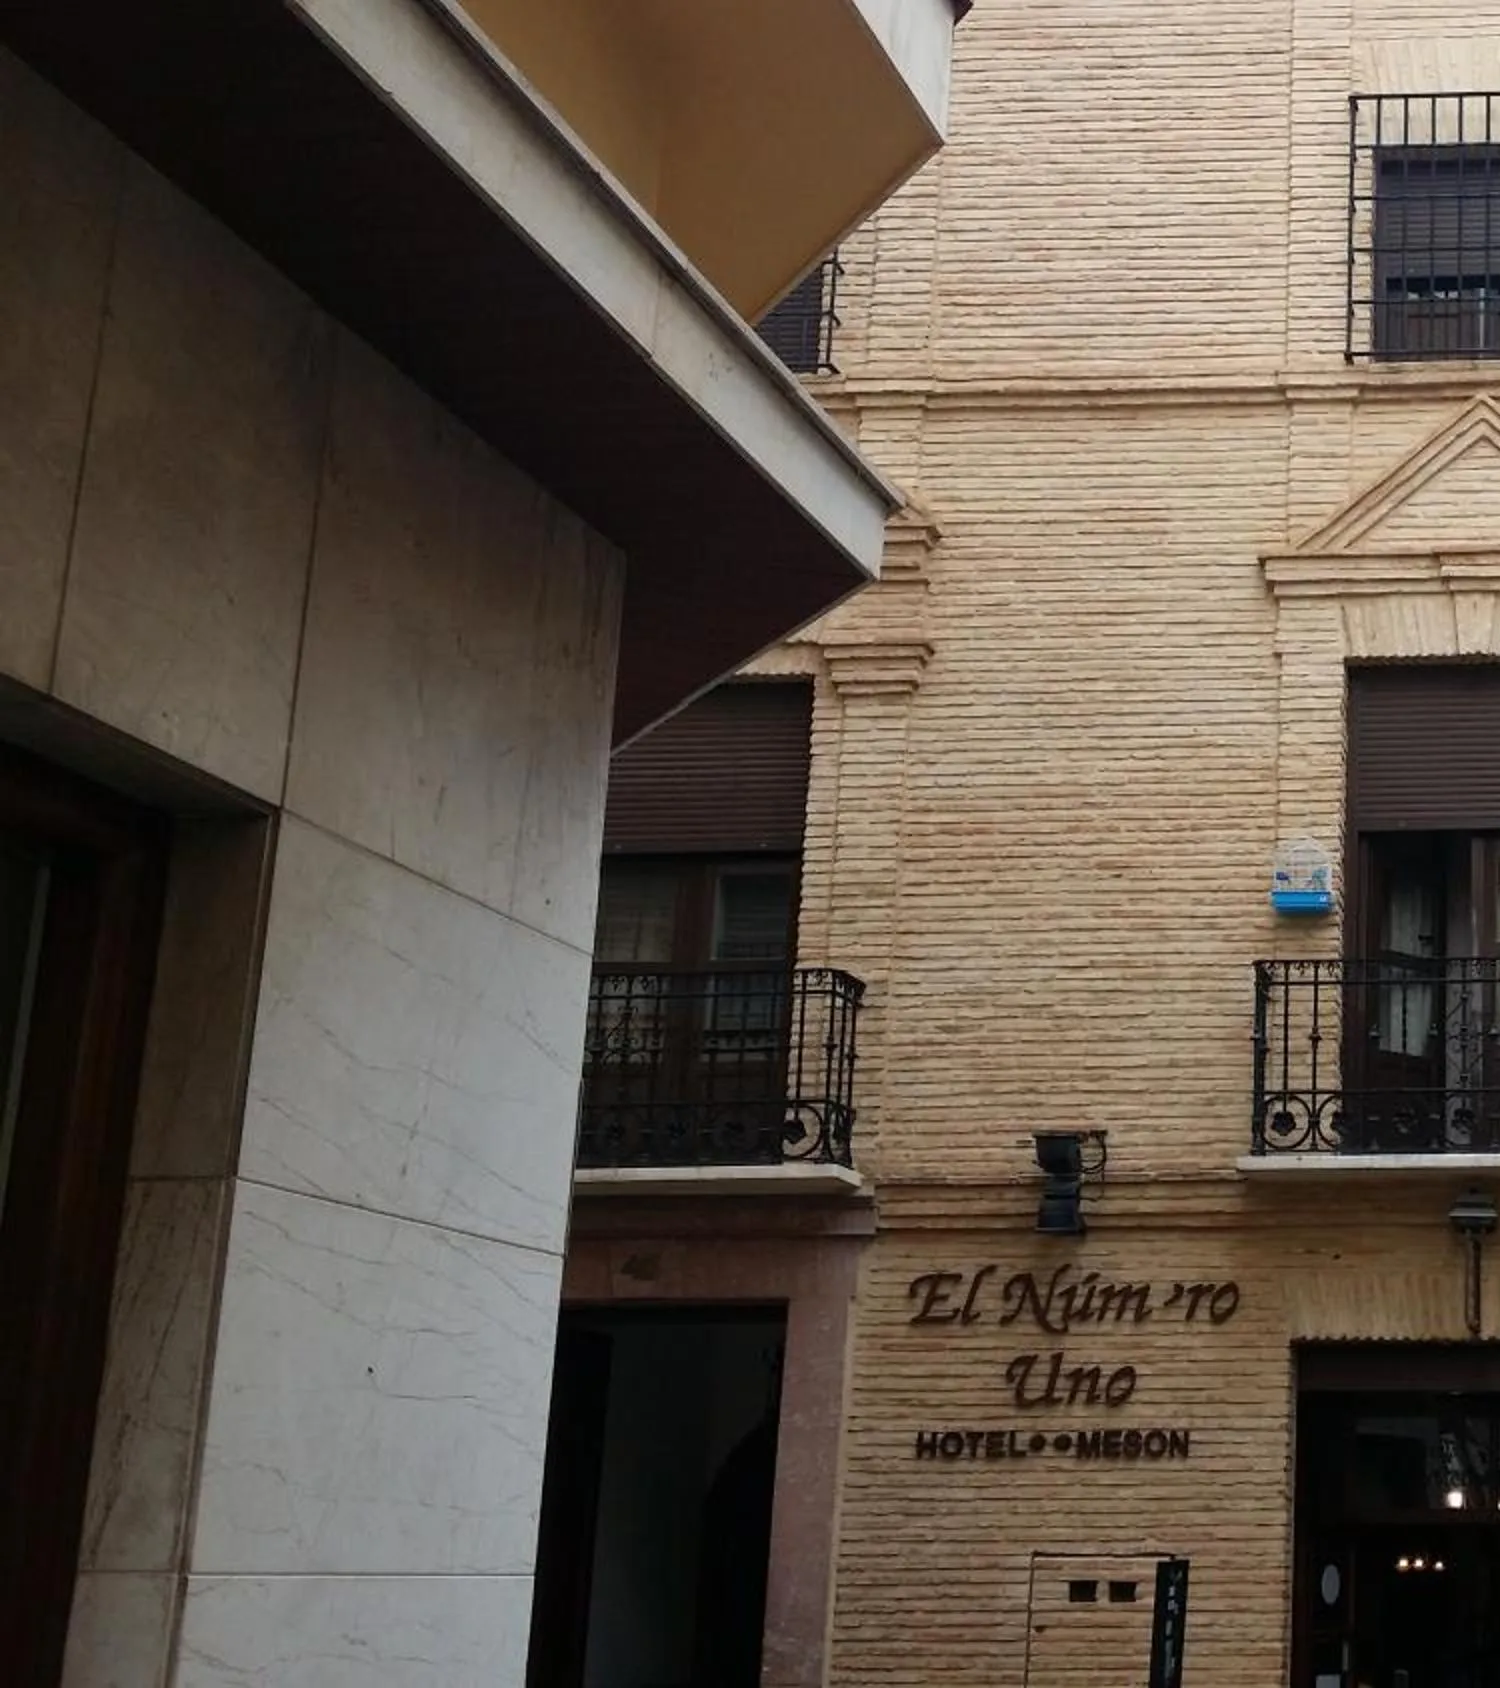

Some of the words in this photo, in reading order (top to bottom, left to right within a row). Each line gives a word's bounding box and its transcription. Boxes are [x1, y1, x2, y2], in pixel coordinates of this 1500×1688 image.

[908, 1264, 997, 1327] El
[1005, 1352, 1137, 1407] Uno
[915, 1430, 1027, 1459] HOTEL
[1075, 1429, 1190, 1459] MESON
